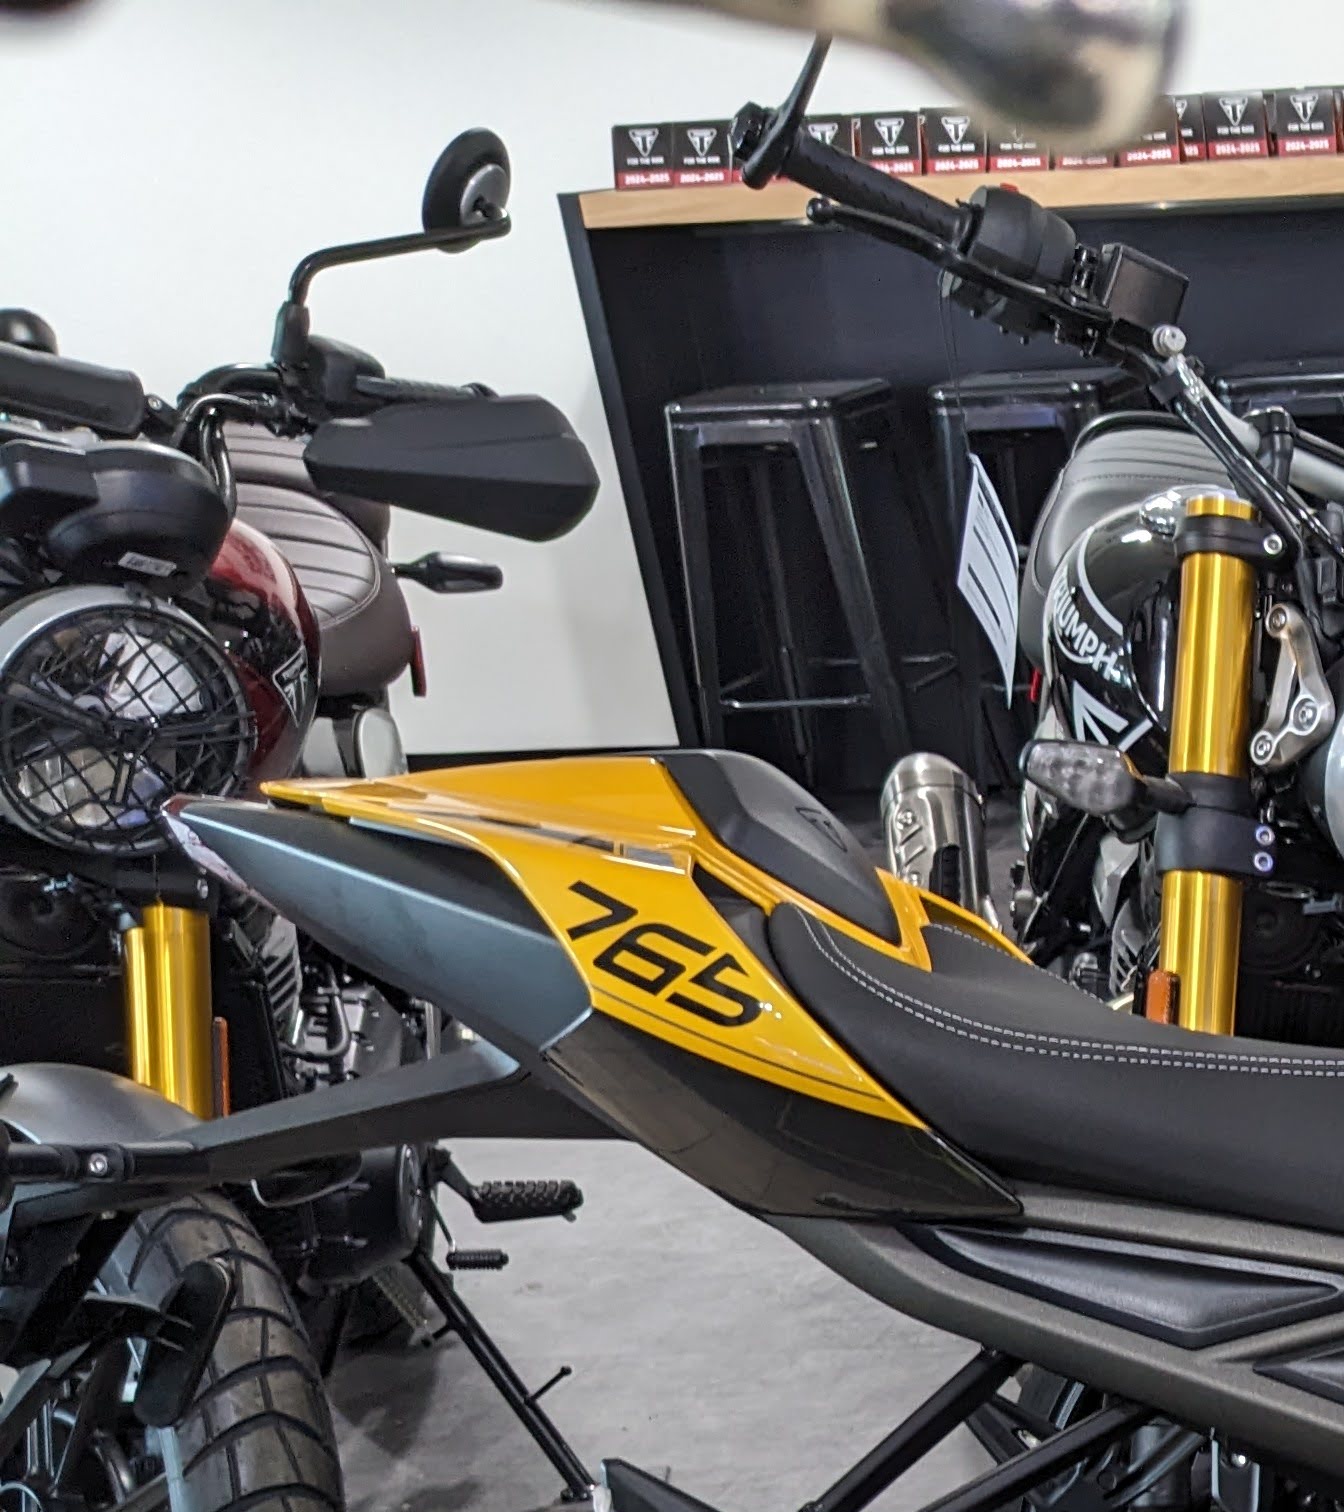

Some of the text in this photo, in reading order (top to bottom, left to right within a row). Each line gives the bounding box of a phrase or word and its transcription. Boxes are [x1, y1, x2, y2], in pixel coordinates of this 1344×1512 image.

[1215, 142, 1260, 155] 2024-2025
[1285, 139, 1329, 152] 2024-2025
[1127, 150, 1171, 162] 2024-2025
[935, 159, 979, 171] 2024-2025
[996, 157, 1041, 169] 2024-2025
[624, 173, 670, 185] 2024-2025
[680, 172, 725, 184] 2024-2025
[566, 879, 762, 1027] 765
